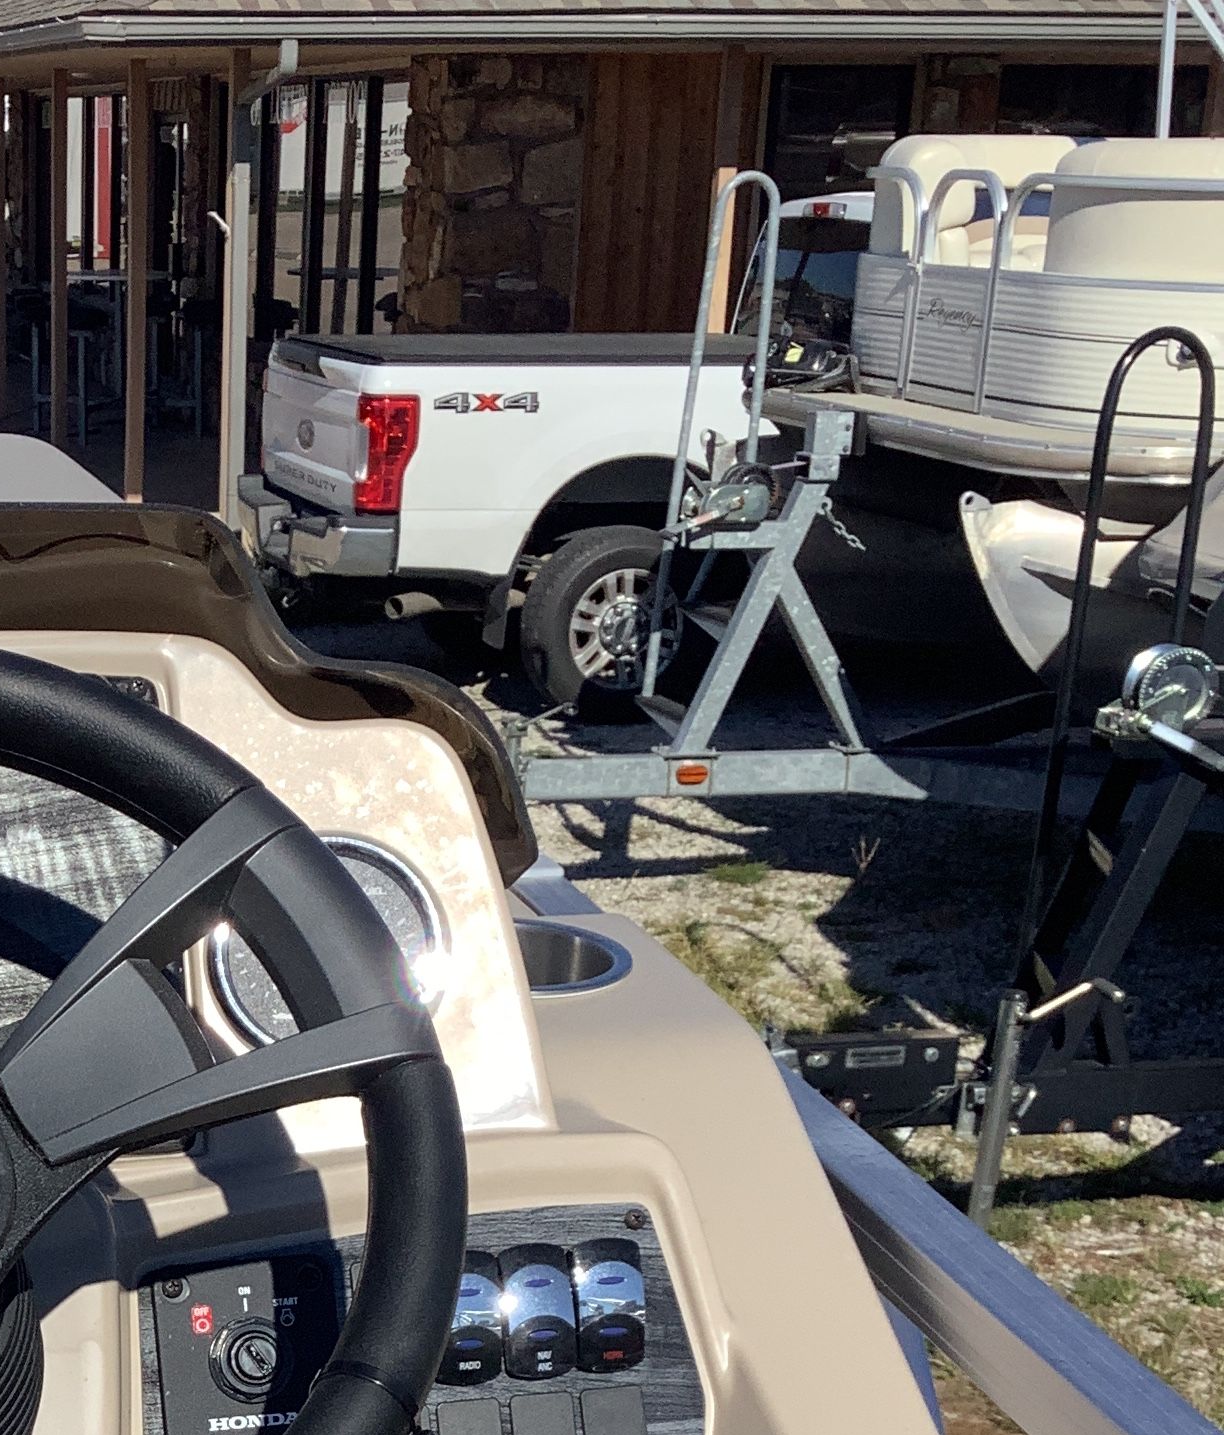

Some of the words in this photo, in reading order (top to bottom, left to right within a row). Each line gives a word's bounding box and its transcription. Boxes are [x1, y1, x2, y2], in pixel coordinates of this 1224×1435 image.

[307, 474, 336, 492] DUTY
[237, 1286, 251, 1296] ON
[272, 1297, 298, 1307] START
[193, 1307, 209, 1317] OFF
[458, 1361, 482, 1371] RADIO
[208, 1412, 298, 1432] HONDA
